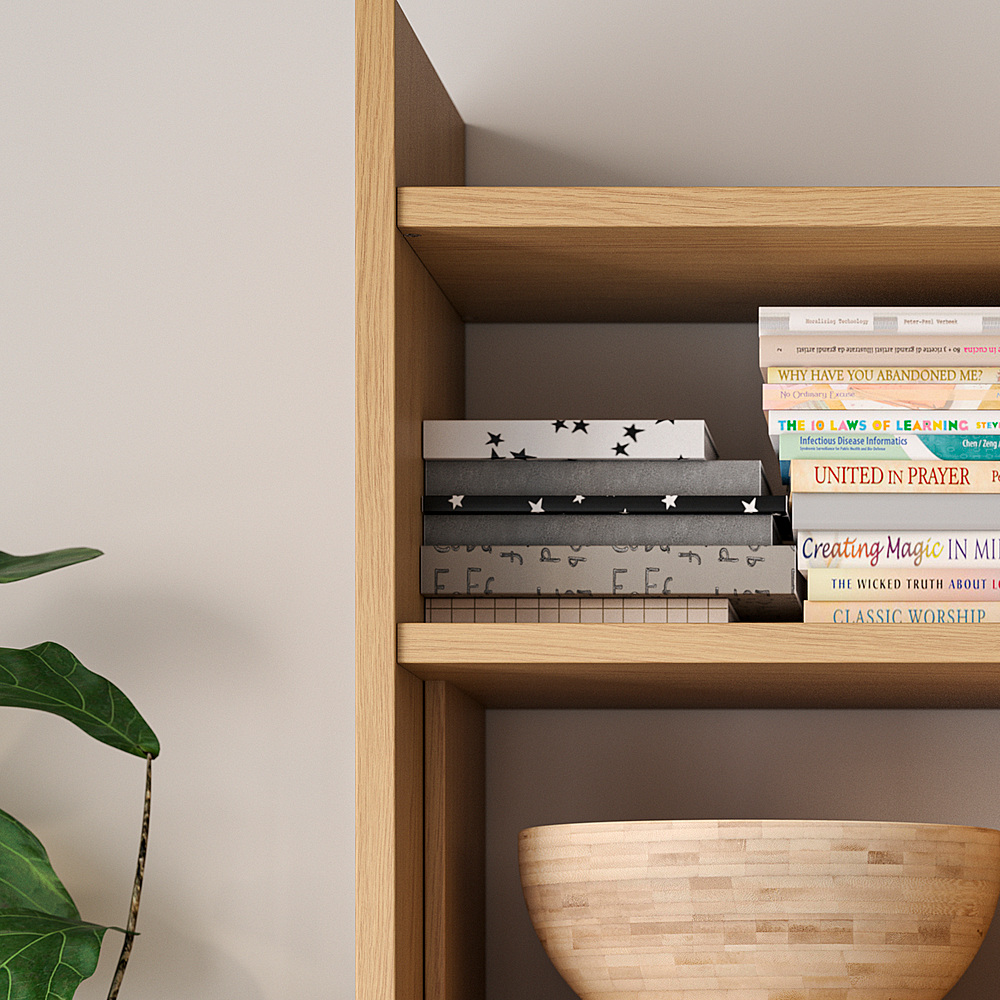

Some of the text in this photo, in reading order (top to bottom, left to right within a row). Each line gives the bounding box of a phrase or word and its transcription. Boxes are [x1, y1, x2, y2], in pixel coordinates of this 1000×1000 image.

[797, 346, 815, 354] artisti
[816, 346, 836, 354] grandi
[846, 346, 874, 354] illustrate
[875, 346, 894, 354] artisti
[895, 346, 915, 354] grandi
[964, 346, 987, 354] cucina
[778, 369, 983, 382] WHY HAVE YOU ABANDONED ME?
[780, 390, 856, 400] No Ordinary Excuse
[778, 420, 969, 432] THE 10 LAWS OF LEARNING
[799, 435, 908, 446] Infectious Disease Informatics
[962, 439, 978, 449] Chen
[982, 439, 998, 449] Zeng
[814, 466, 970, 485] UNITED IN PRAYER
[802, 537, 884, 567] Creating
[886, 536, 944, 566] Magic
[948, 539, 967, 560] IN
[831, 578, 853, 590] THE
[856, 578, 901, 590] WICKED
[906, 578, 944, 590] TRUTH
[948, 578, 987, 590] ABOUT
[832, 609, 986, 623] CLASSIC WORSHIP
